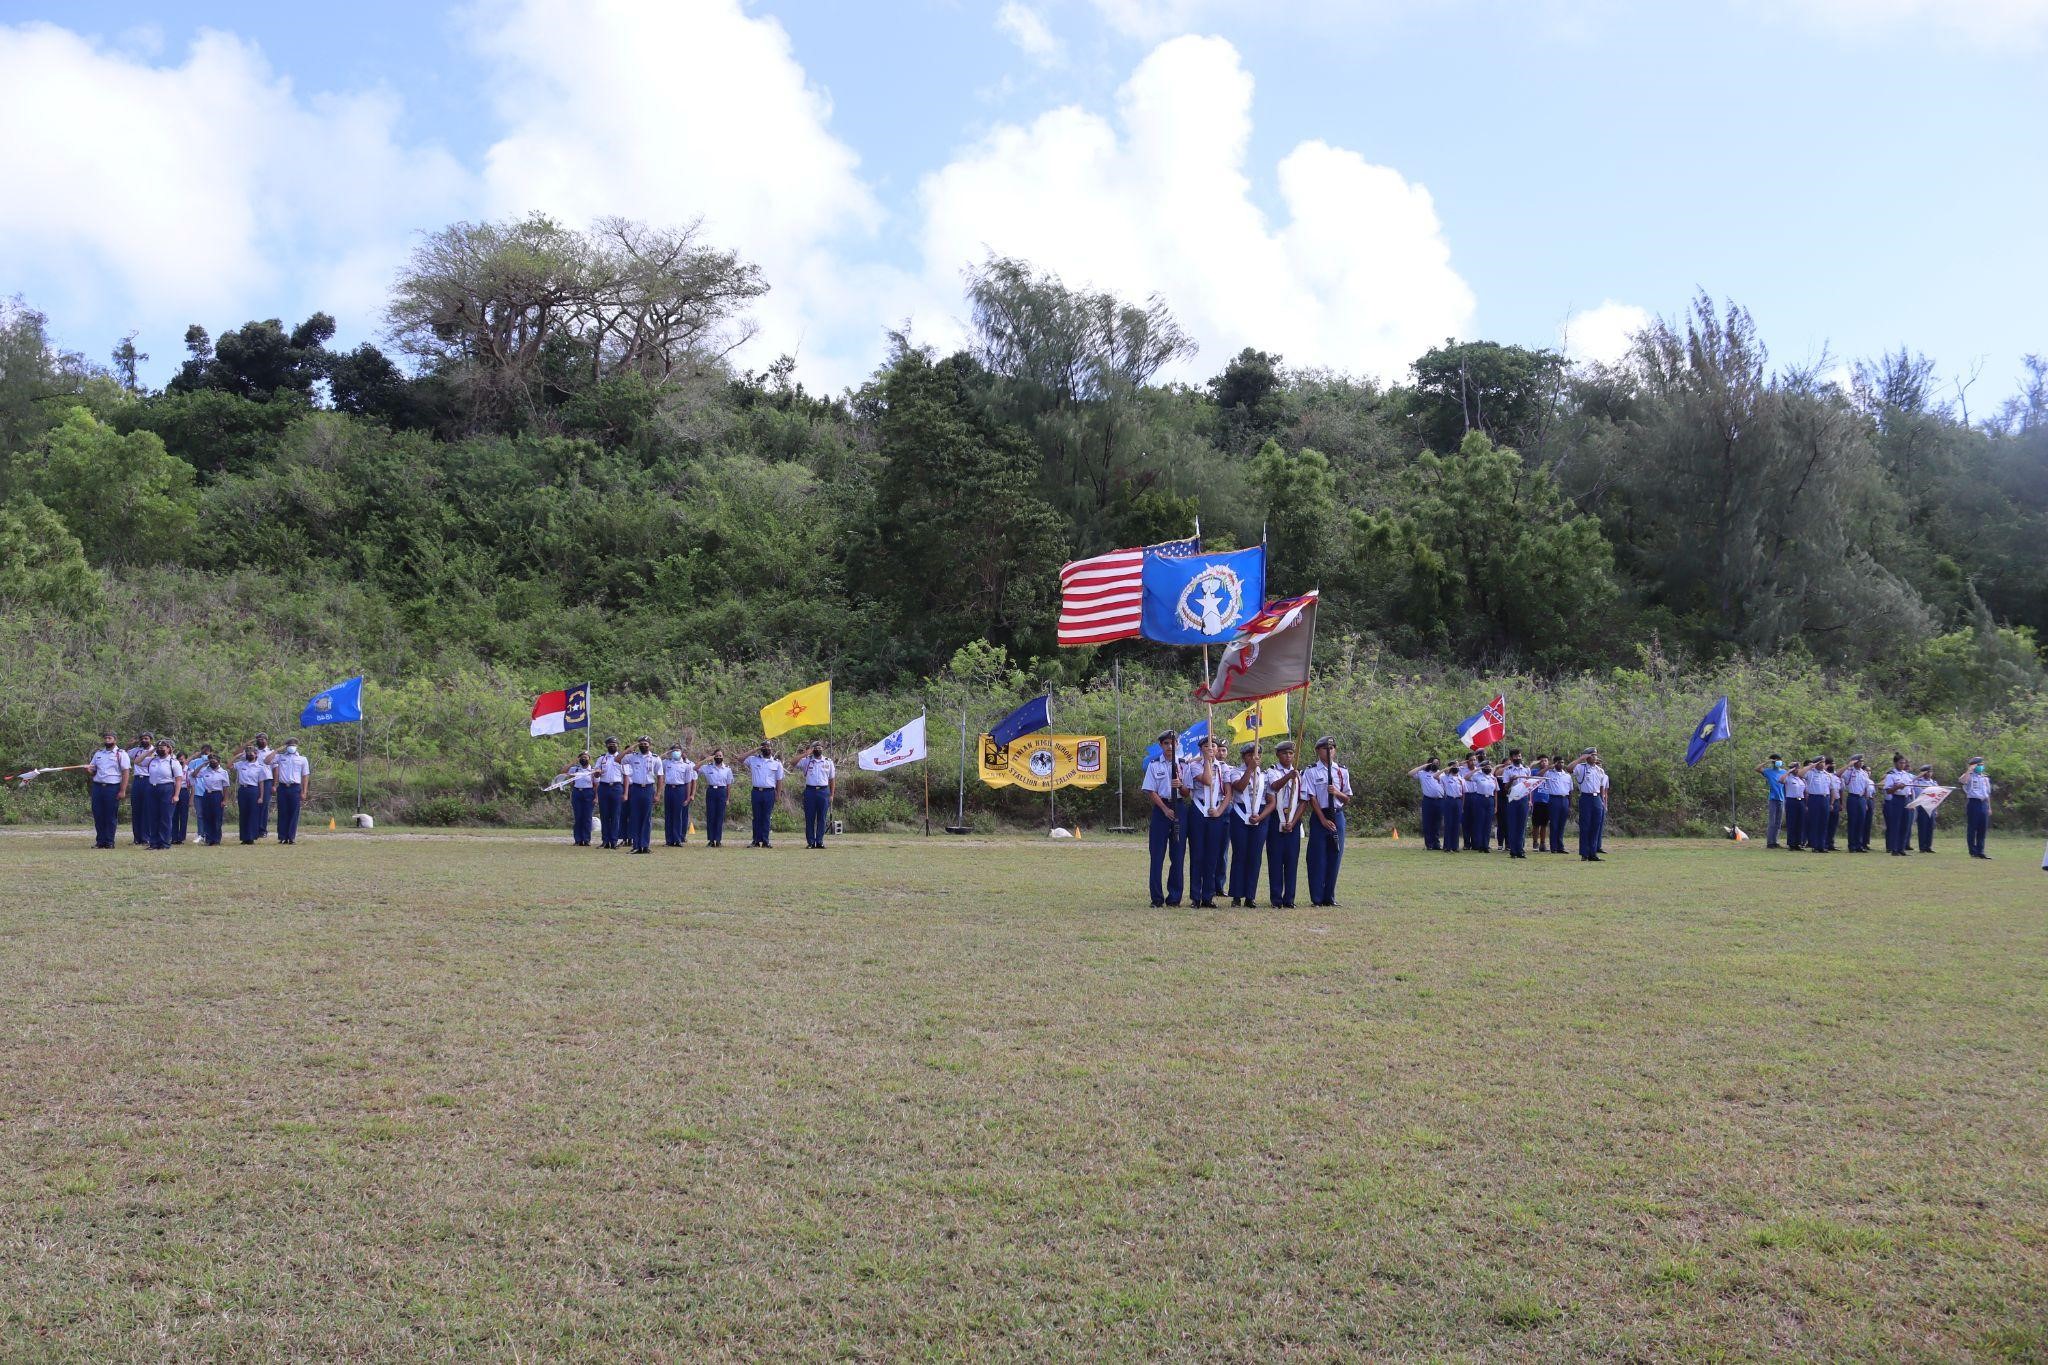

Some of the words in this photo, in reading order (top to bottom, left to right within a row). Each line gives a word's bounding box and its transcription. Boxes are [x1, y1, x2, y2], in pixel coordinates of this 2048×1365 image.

[1011, 742, 1033, 761] TINIAN
[1036, 739, 1052, 747] HIGH
[1055, 743, 1074, 763] SCHOOL
[1009, 768, 1038, 787] STALLION
